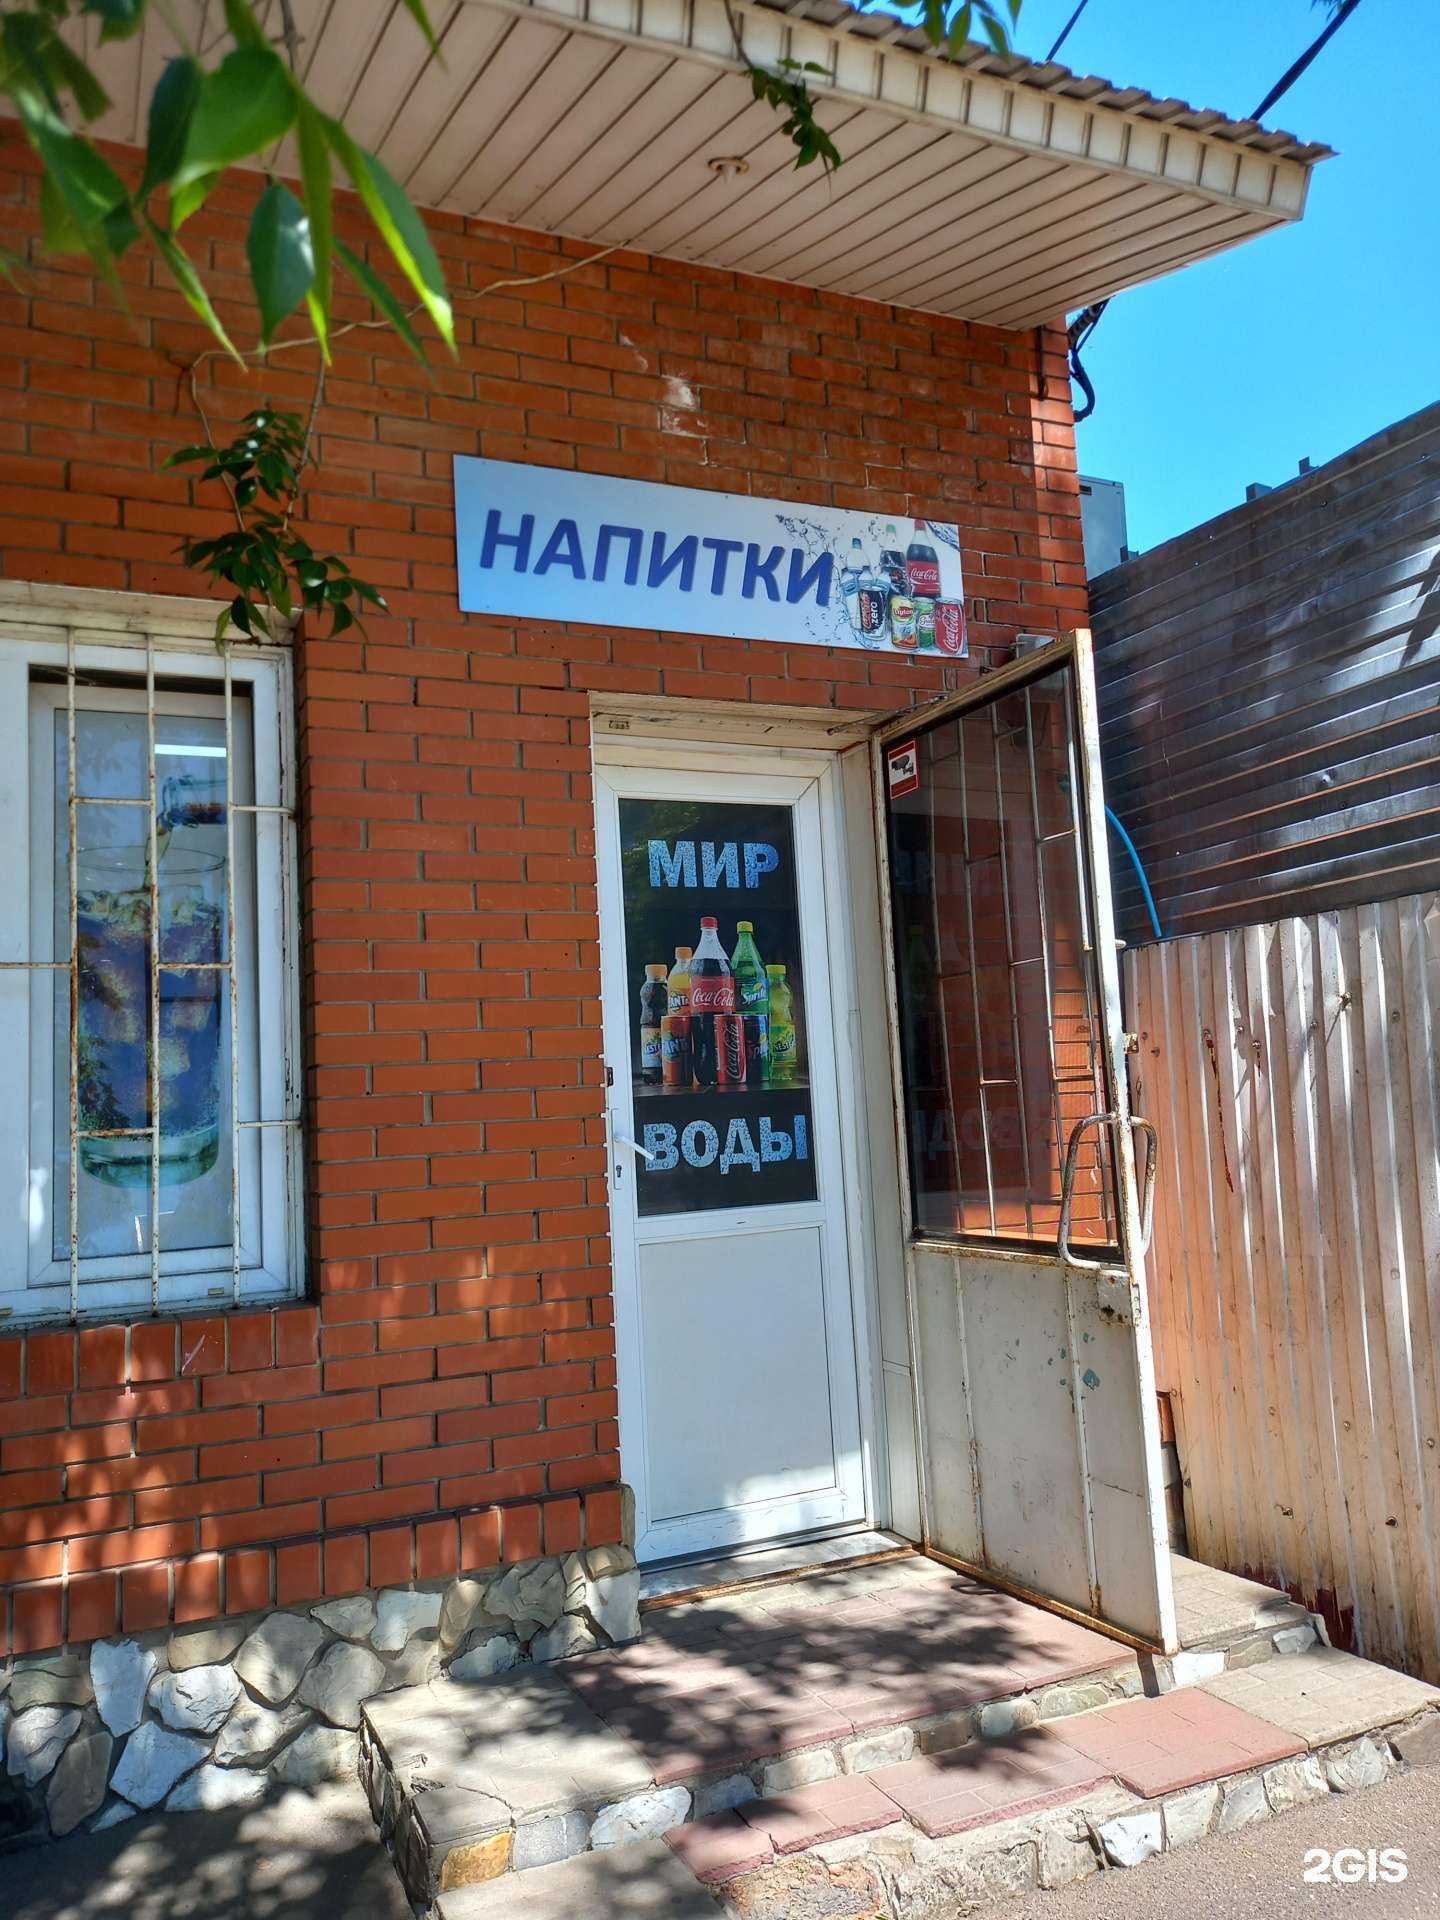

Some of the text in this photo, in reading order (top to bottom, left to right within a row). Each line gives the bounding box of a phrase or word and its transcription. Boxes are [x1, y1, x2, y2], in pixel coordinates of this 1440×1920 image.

[479, 508, 835, 607] НАПИТКИ
[870, 602, 879, 625] zero
[647, 840, 780, 889] МИР
[692, 988, 735, 1007] Coca-Cola
[643, 1114, 808, 1175] ВОДЫ
